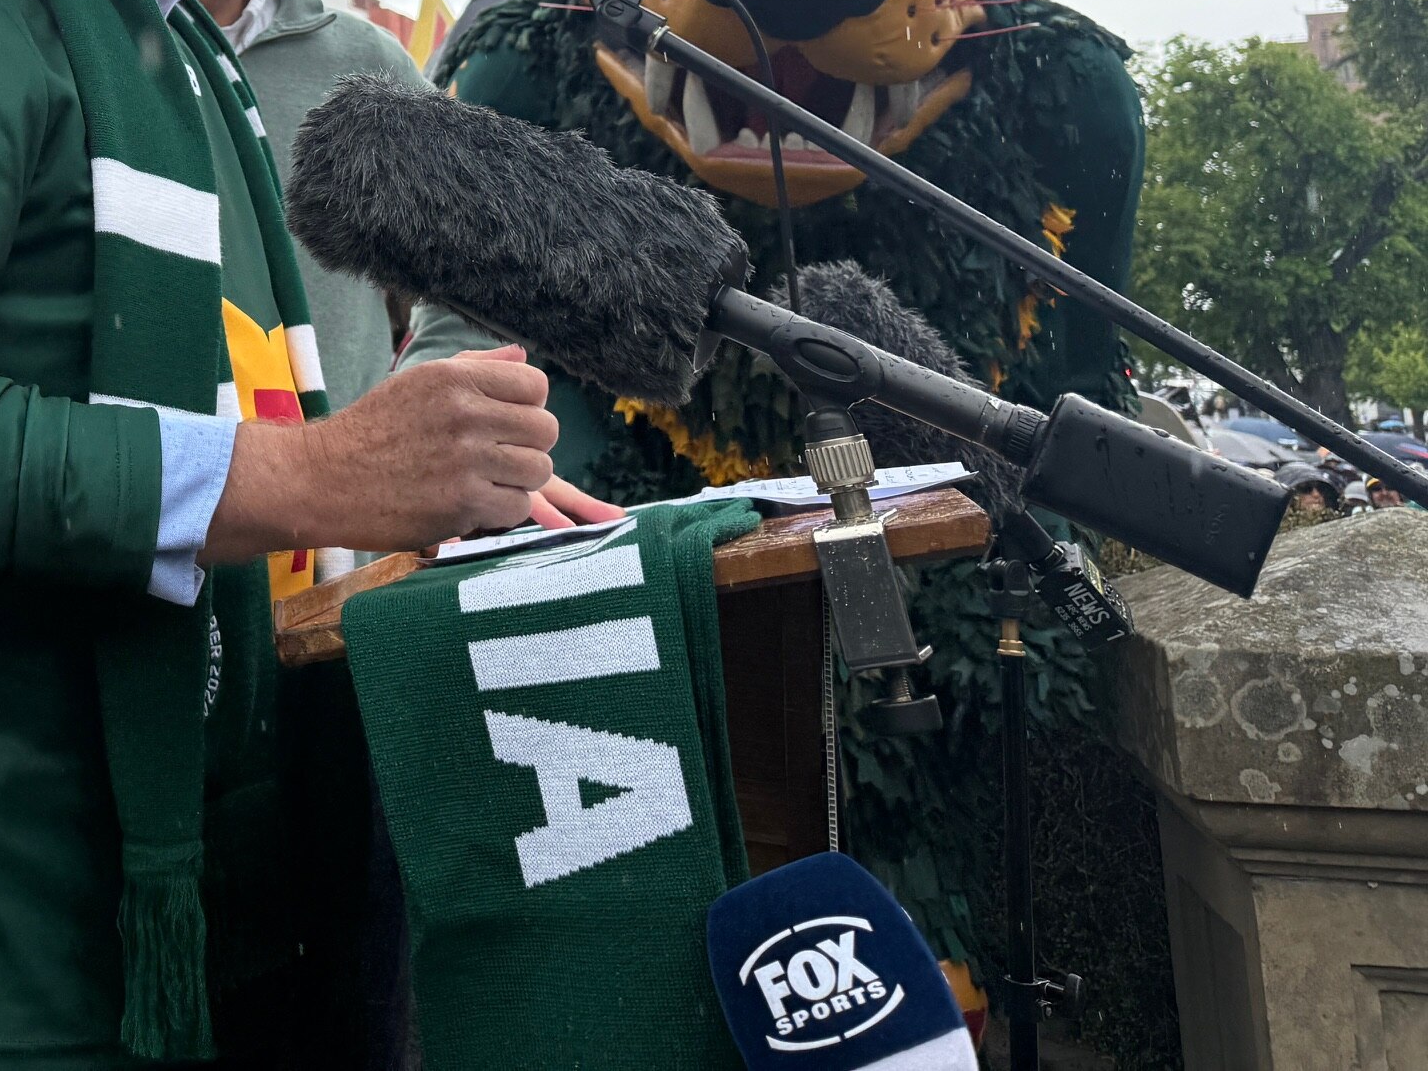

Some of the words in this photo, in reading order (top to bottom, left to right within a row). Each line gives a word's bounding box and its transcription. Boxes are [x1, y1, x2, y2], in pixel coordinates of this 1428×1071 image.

[1063, 582, 1111, 625] NEWS
[1106, 629, 1126, 642] 1
[753, 930, 880, 1020] FOX
[775, 979, 888, 1036] SPORTS
